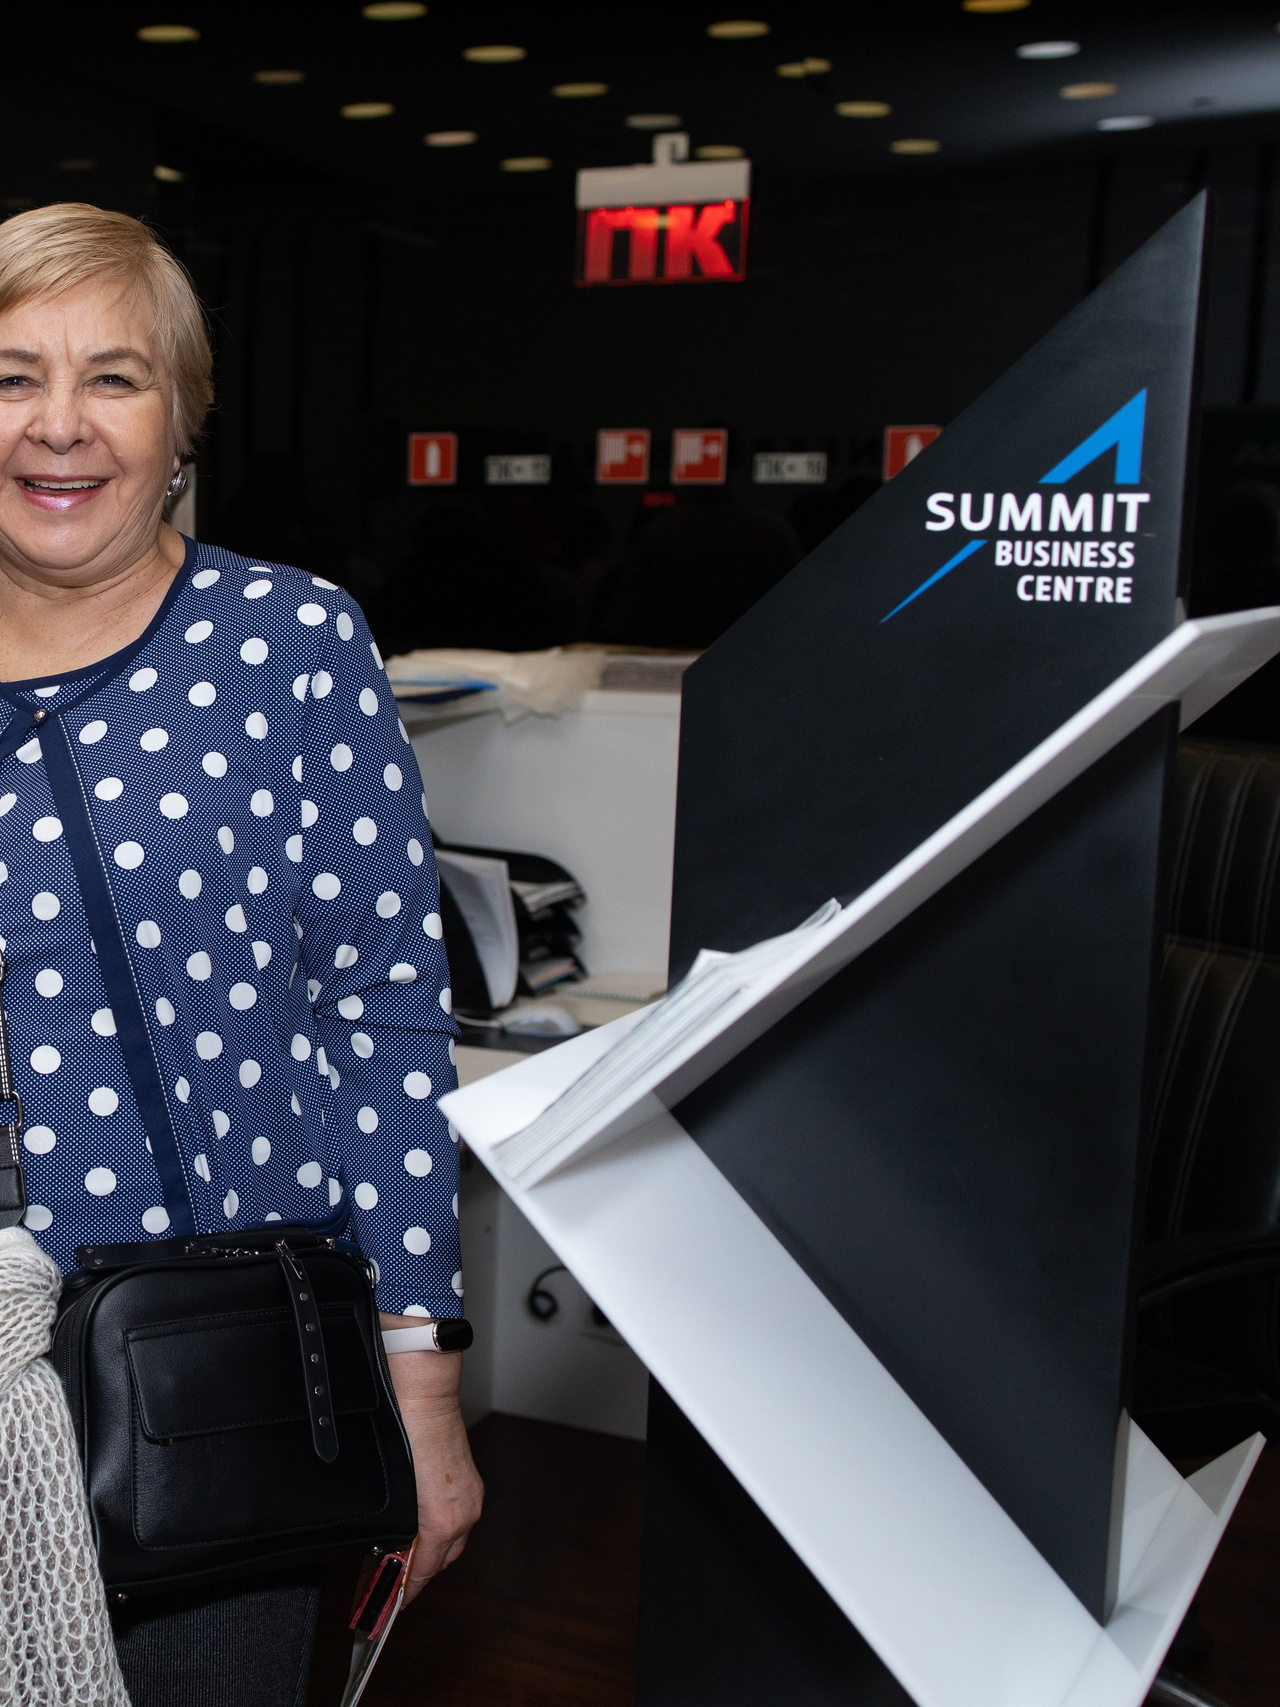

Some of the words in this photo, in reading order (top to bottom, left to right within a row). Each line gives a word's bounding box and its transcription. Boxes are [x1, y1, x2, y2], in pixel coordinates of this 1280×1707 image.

[584, 205, 736, 283] ПК
[925, 492, 1150, 533] SUMMIT
[995, 540, 1135, 568] BUSINESS
[1016, 575, 1133, 603] CENTRE
